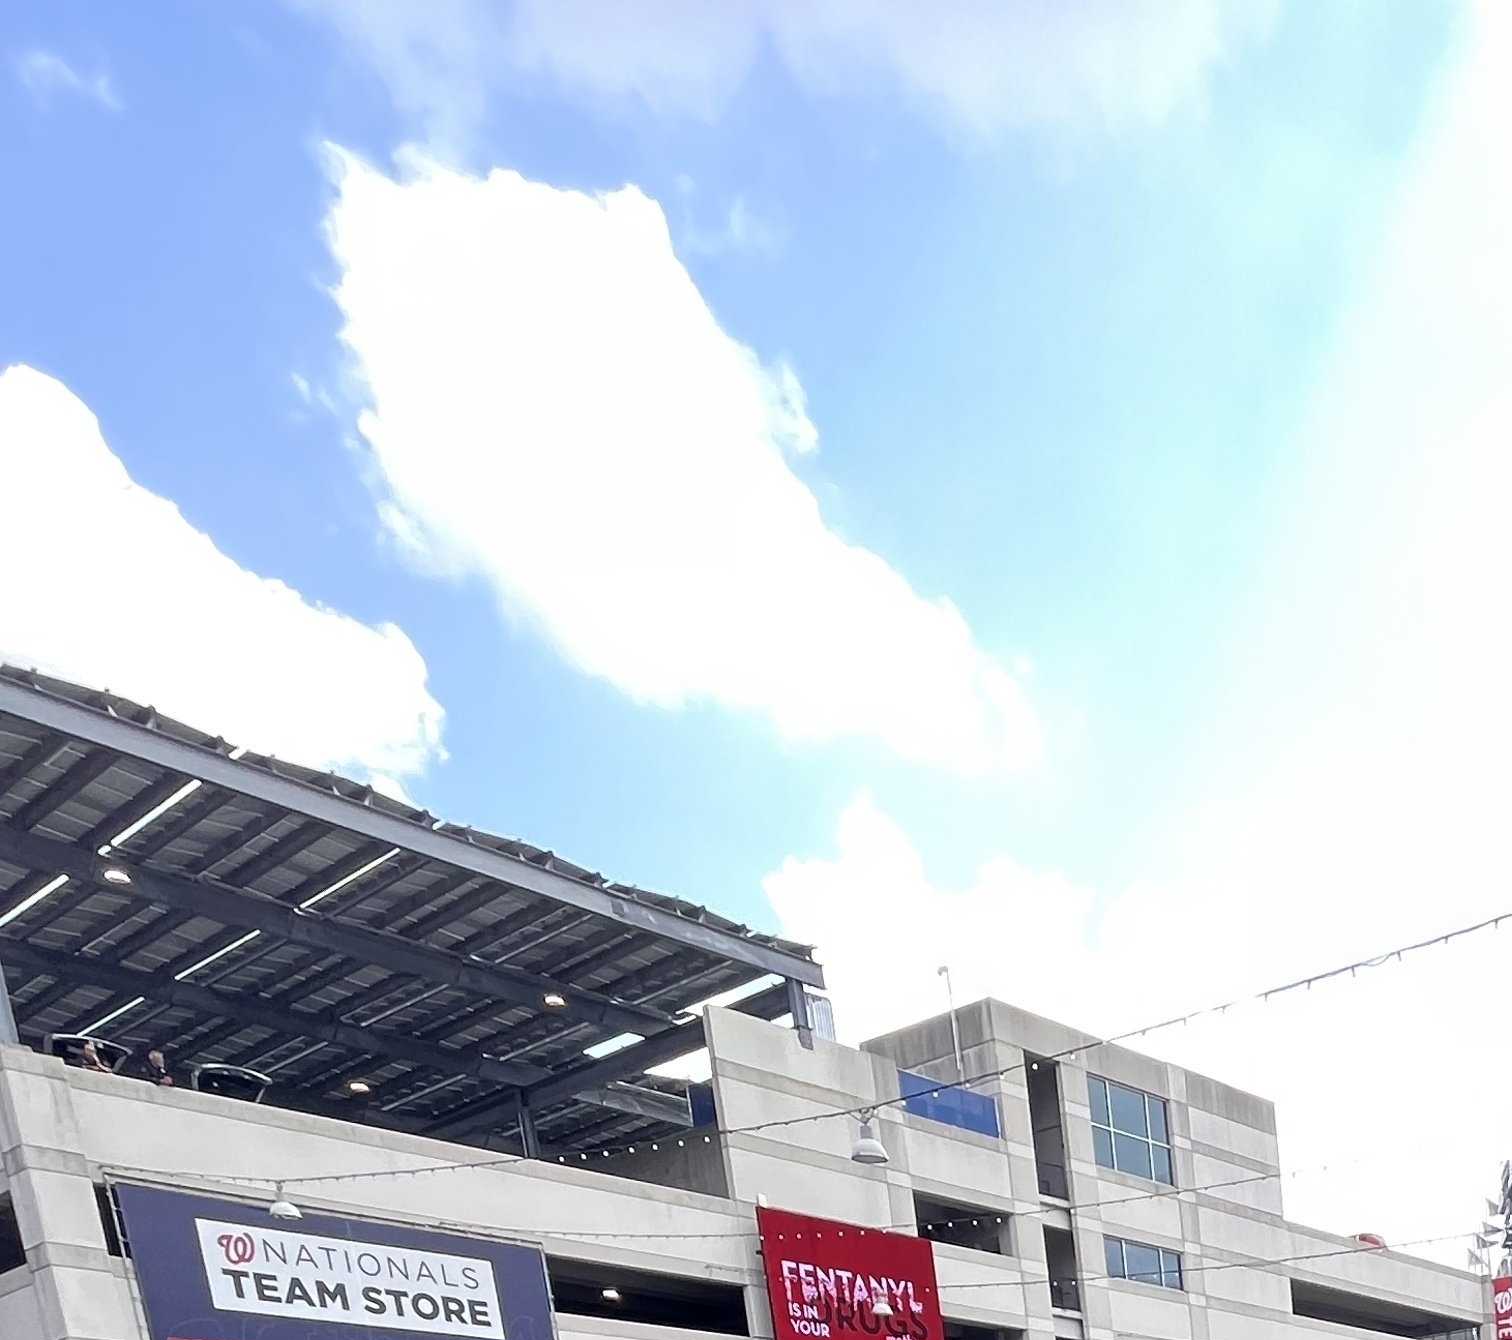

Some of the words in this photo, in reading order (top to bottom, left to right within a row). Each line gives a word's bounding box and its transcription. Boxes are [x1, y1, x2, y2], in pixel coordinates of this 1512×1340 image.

[262, 1238, 479, 1290] NATIONALS
[781, 1260, 923, 1314] FENTANYL
[222, 1268, 350, 1311] TEAM
[363, 1286, 492, 1327] STORE
[788, 1302, 802, 1317] IS
[803, 1304, 818, 1319] IN
[790, 1319, 830, 1338] YOUR
